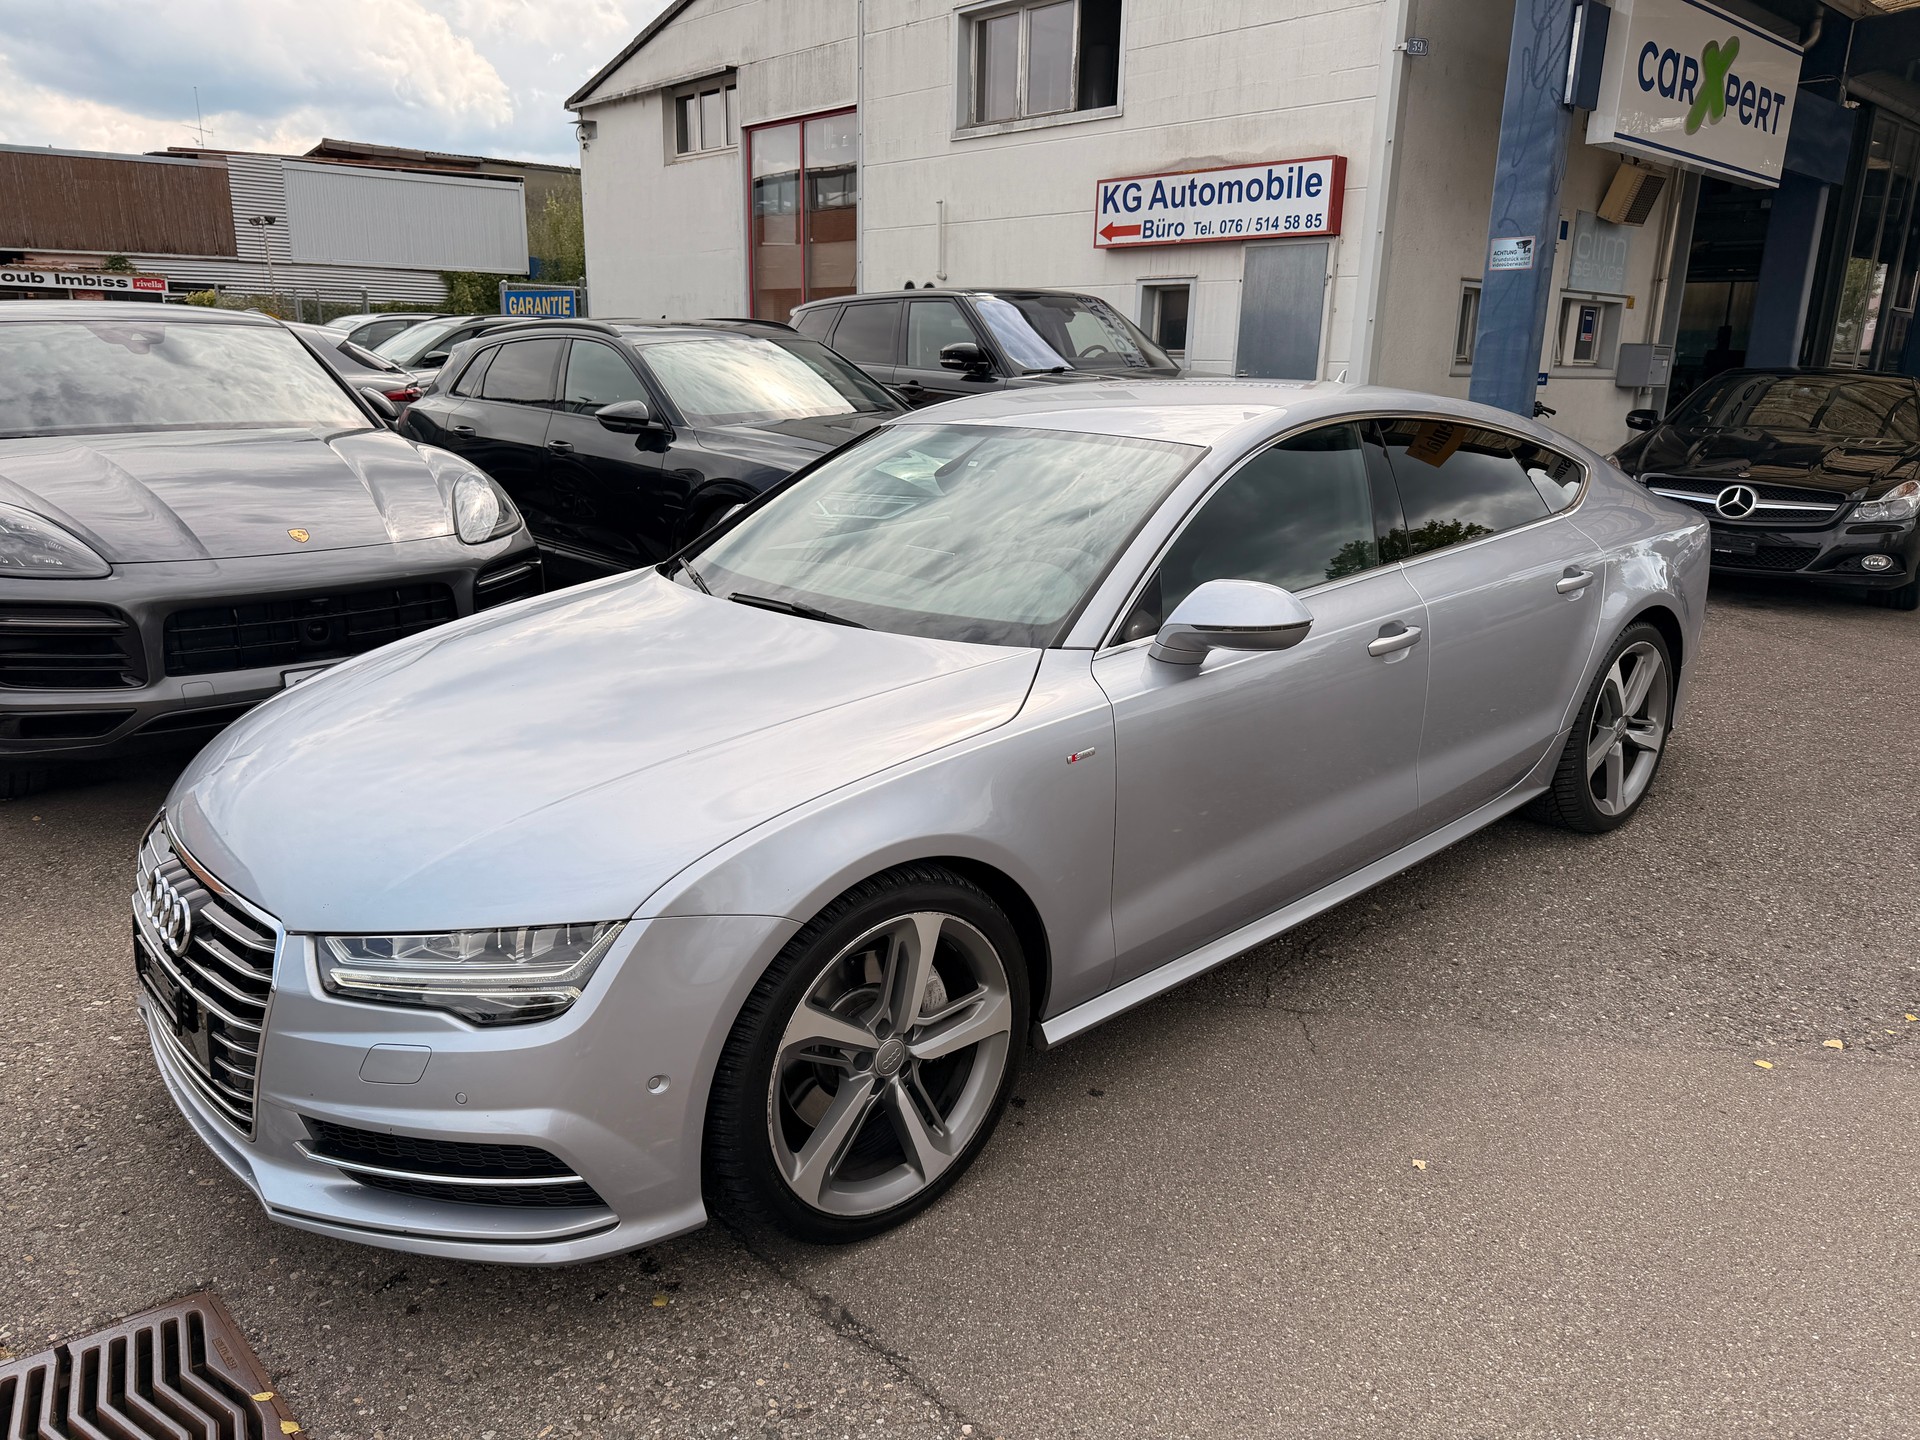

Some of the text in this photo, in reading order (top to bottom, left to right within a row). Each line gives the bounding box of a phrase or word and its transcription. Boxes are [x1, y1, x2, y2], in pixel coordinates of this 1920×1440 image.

[1102, 165, 1323, 214] KG Automobile
[1142, 217, 1185, 239] Büro
[1193, 220, 1215, 236] Tel.
[1219, 218, 1243, 234] 076
[1255, 215, 1280, 232] 514
[1283, 214, 1301, 230] 58
[1304, 213, 1323, 229] 85
[55, 273, 129, 288] Imbiss
[1572, 260, 1624, 281] service
[136, 279, 163, 289] rivella
[508, 295, 571, 316] GARANTIE
